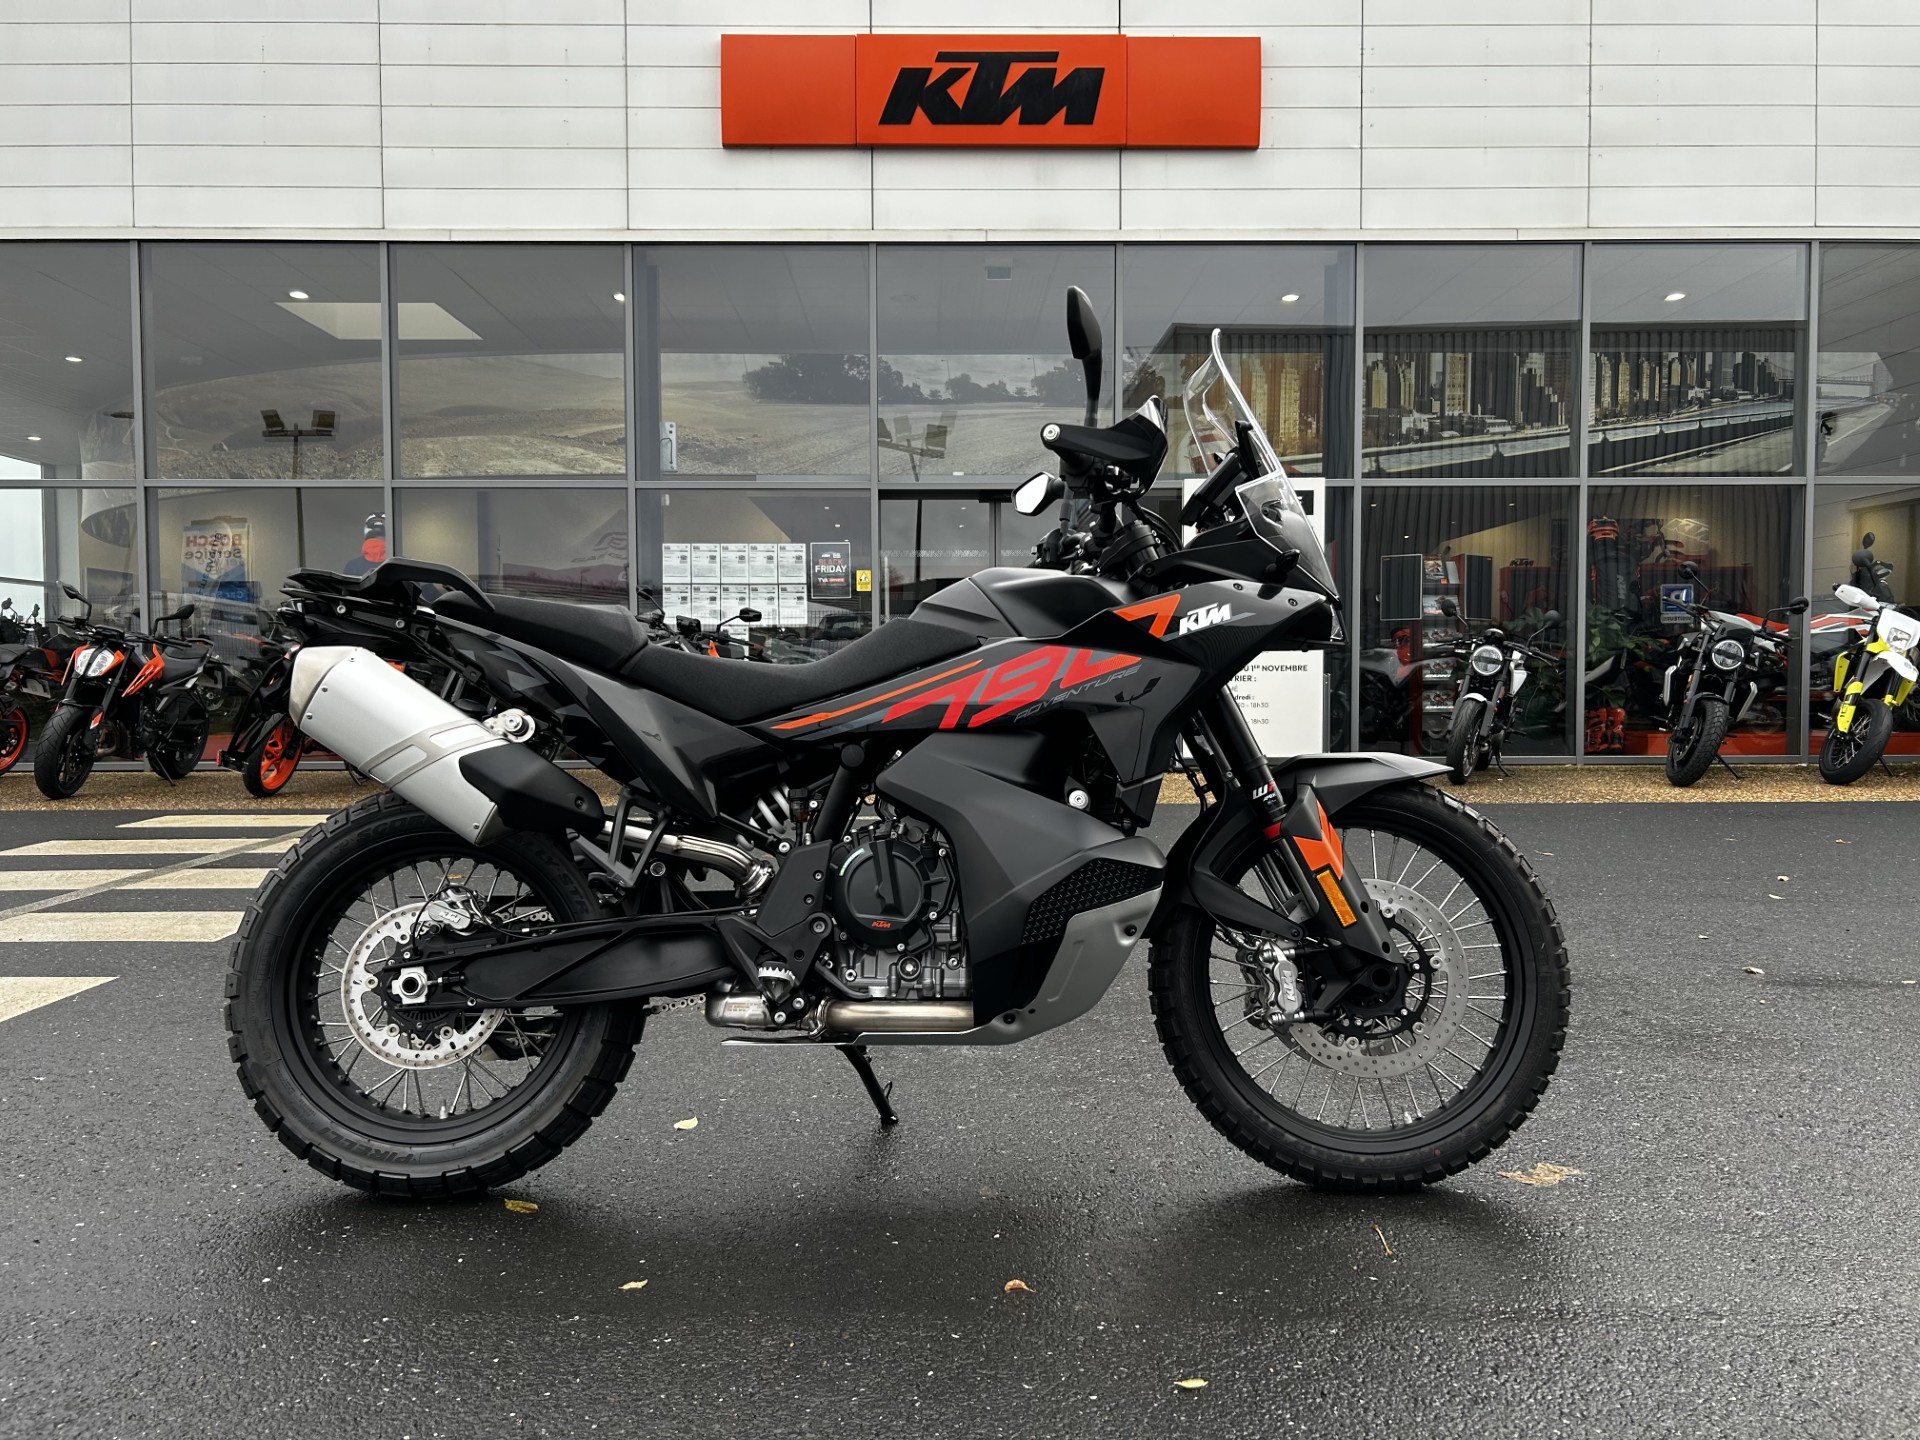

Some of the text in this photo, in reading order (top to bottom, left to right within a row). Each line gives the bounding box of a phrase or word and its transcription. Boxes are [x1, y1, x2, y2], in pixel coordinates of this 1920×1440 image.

[878, 51, 1105, 126] KTM
[815, 564, 847, 573] FRIDAY
[1179, 602, 1233, 636] KTM
[1261, 664, 1308, 672] NOVEMBRE
[1014, 664, 1143, 723] ADVENTURE
[871, 920, 892, 929] KTM
